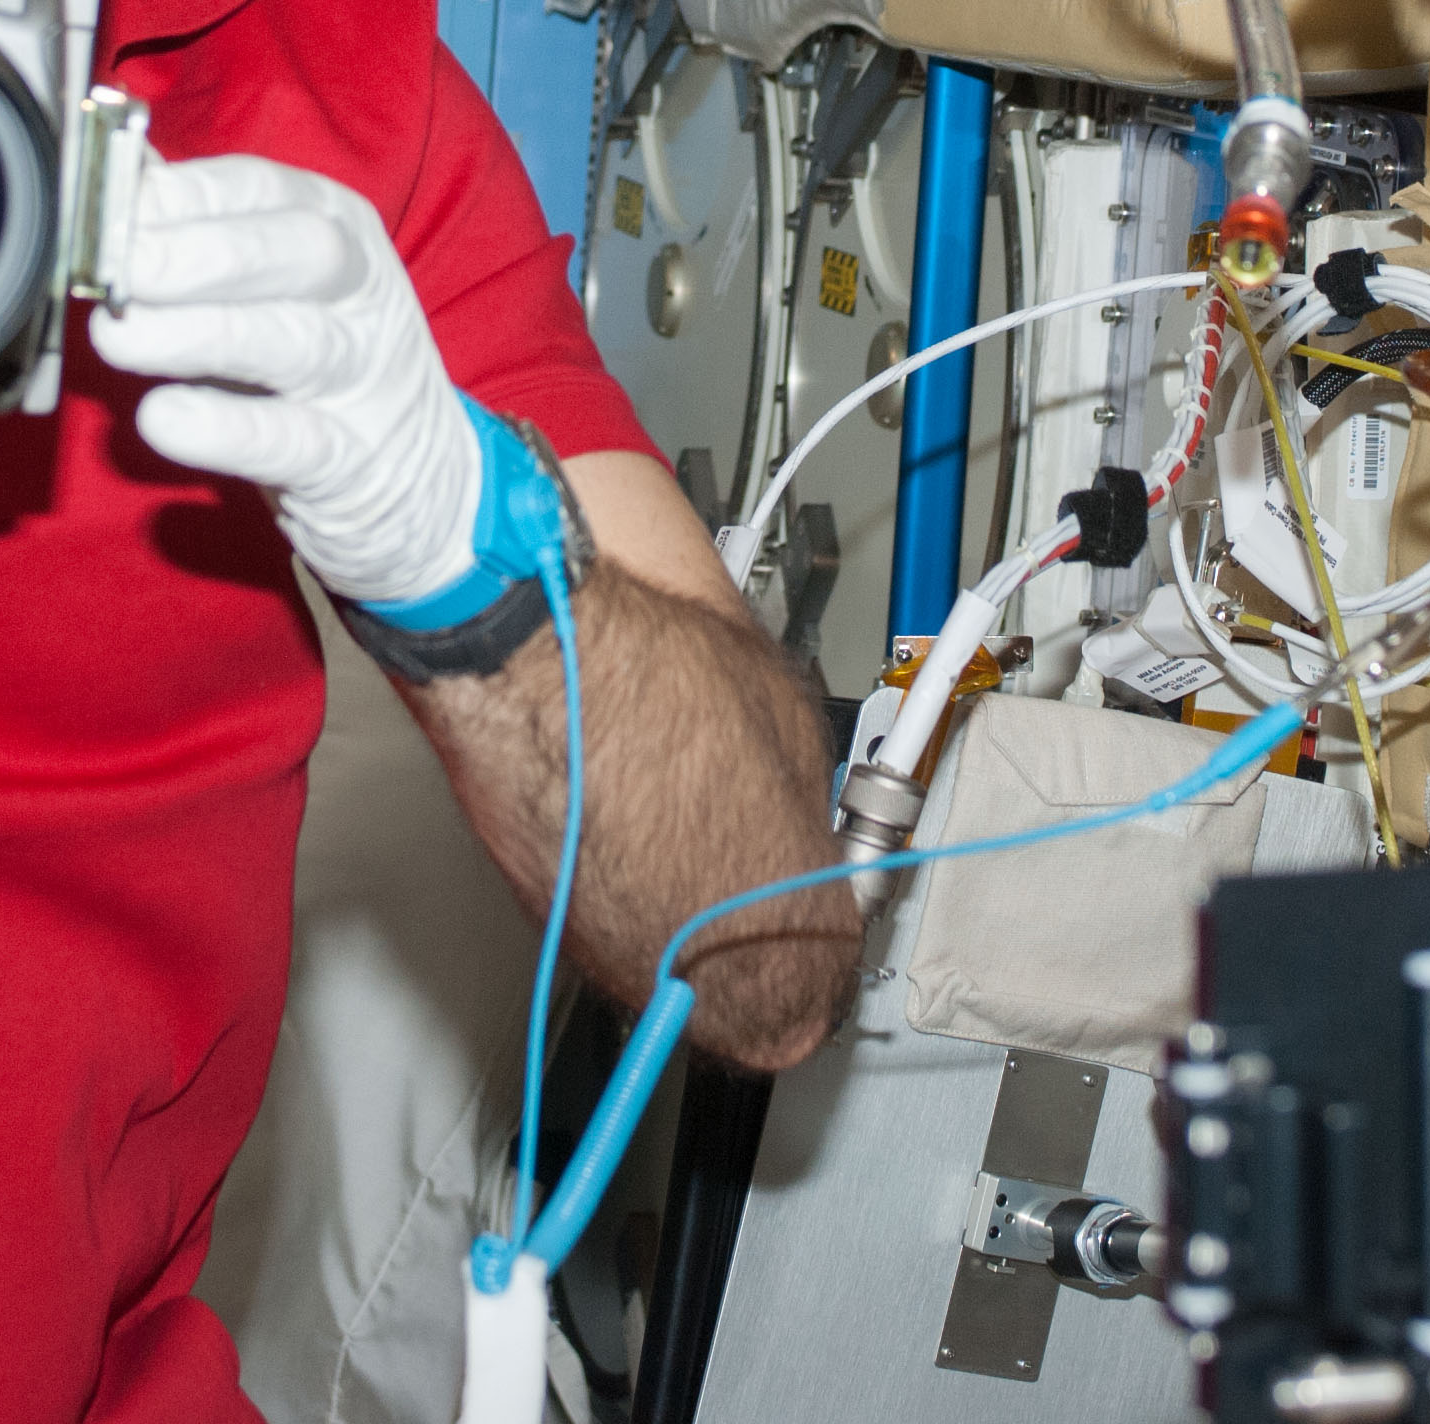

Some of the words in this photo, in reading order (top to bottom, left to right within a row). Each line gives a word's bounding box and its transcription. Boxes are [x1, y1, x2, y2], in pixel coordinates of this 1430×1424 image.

[1349, 414, 1359, 457] Protector
[1143, 671, 1164, 685] Cable
[1163, 659, 1187, 678] Adapter
